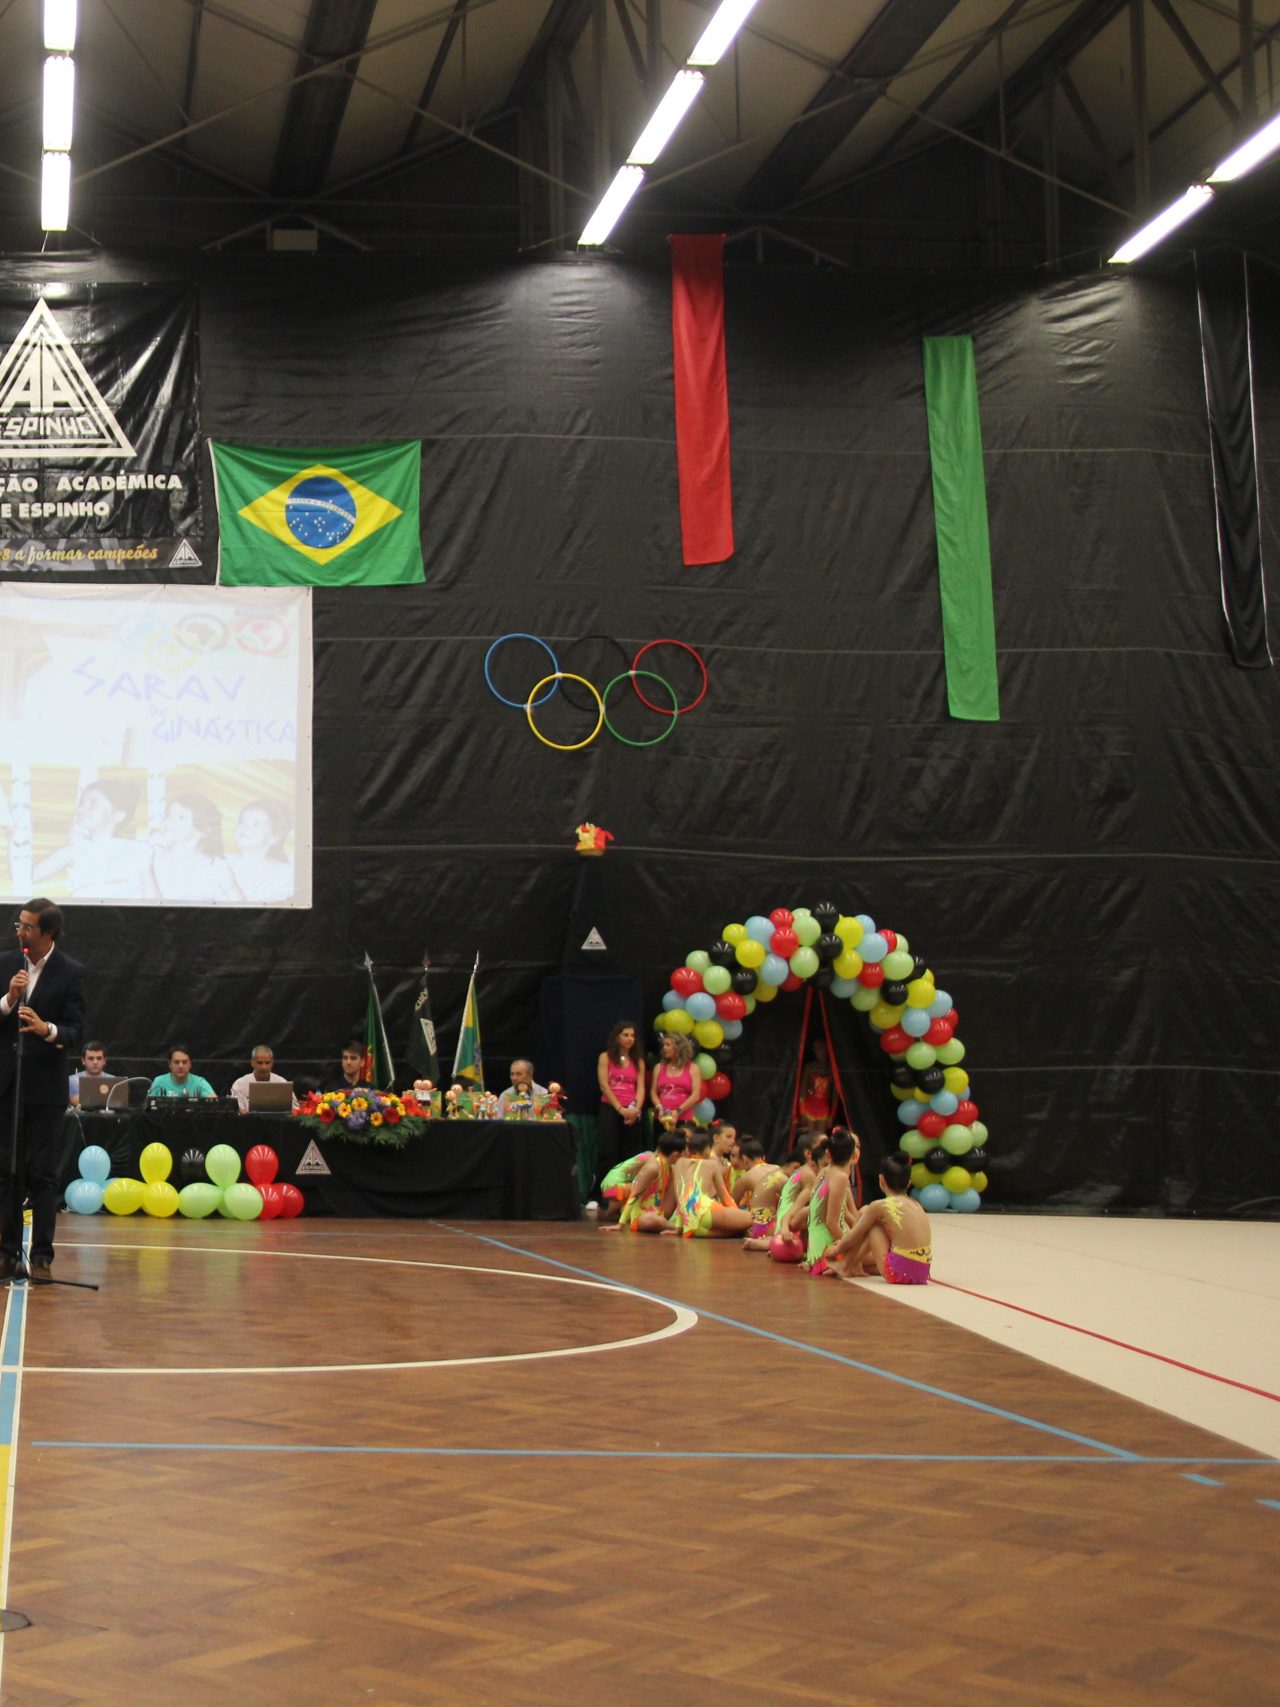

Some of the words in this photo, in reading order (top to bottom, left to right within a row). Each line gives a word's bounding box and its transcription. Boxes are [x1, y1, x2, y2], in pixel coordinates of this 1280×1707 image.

[57, 470, 182, 491] ACADÉMICA
[19, 502, 109, 518] ESPINHO
[14, 550, 25, 560] a
[26, 545, 83, 565] formar
[87, 544, 158, 565] campeões
